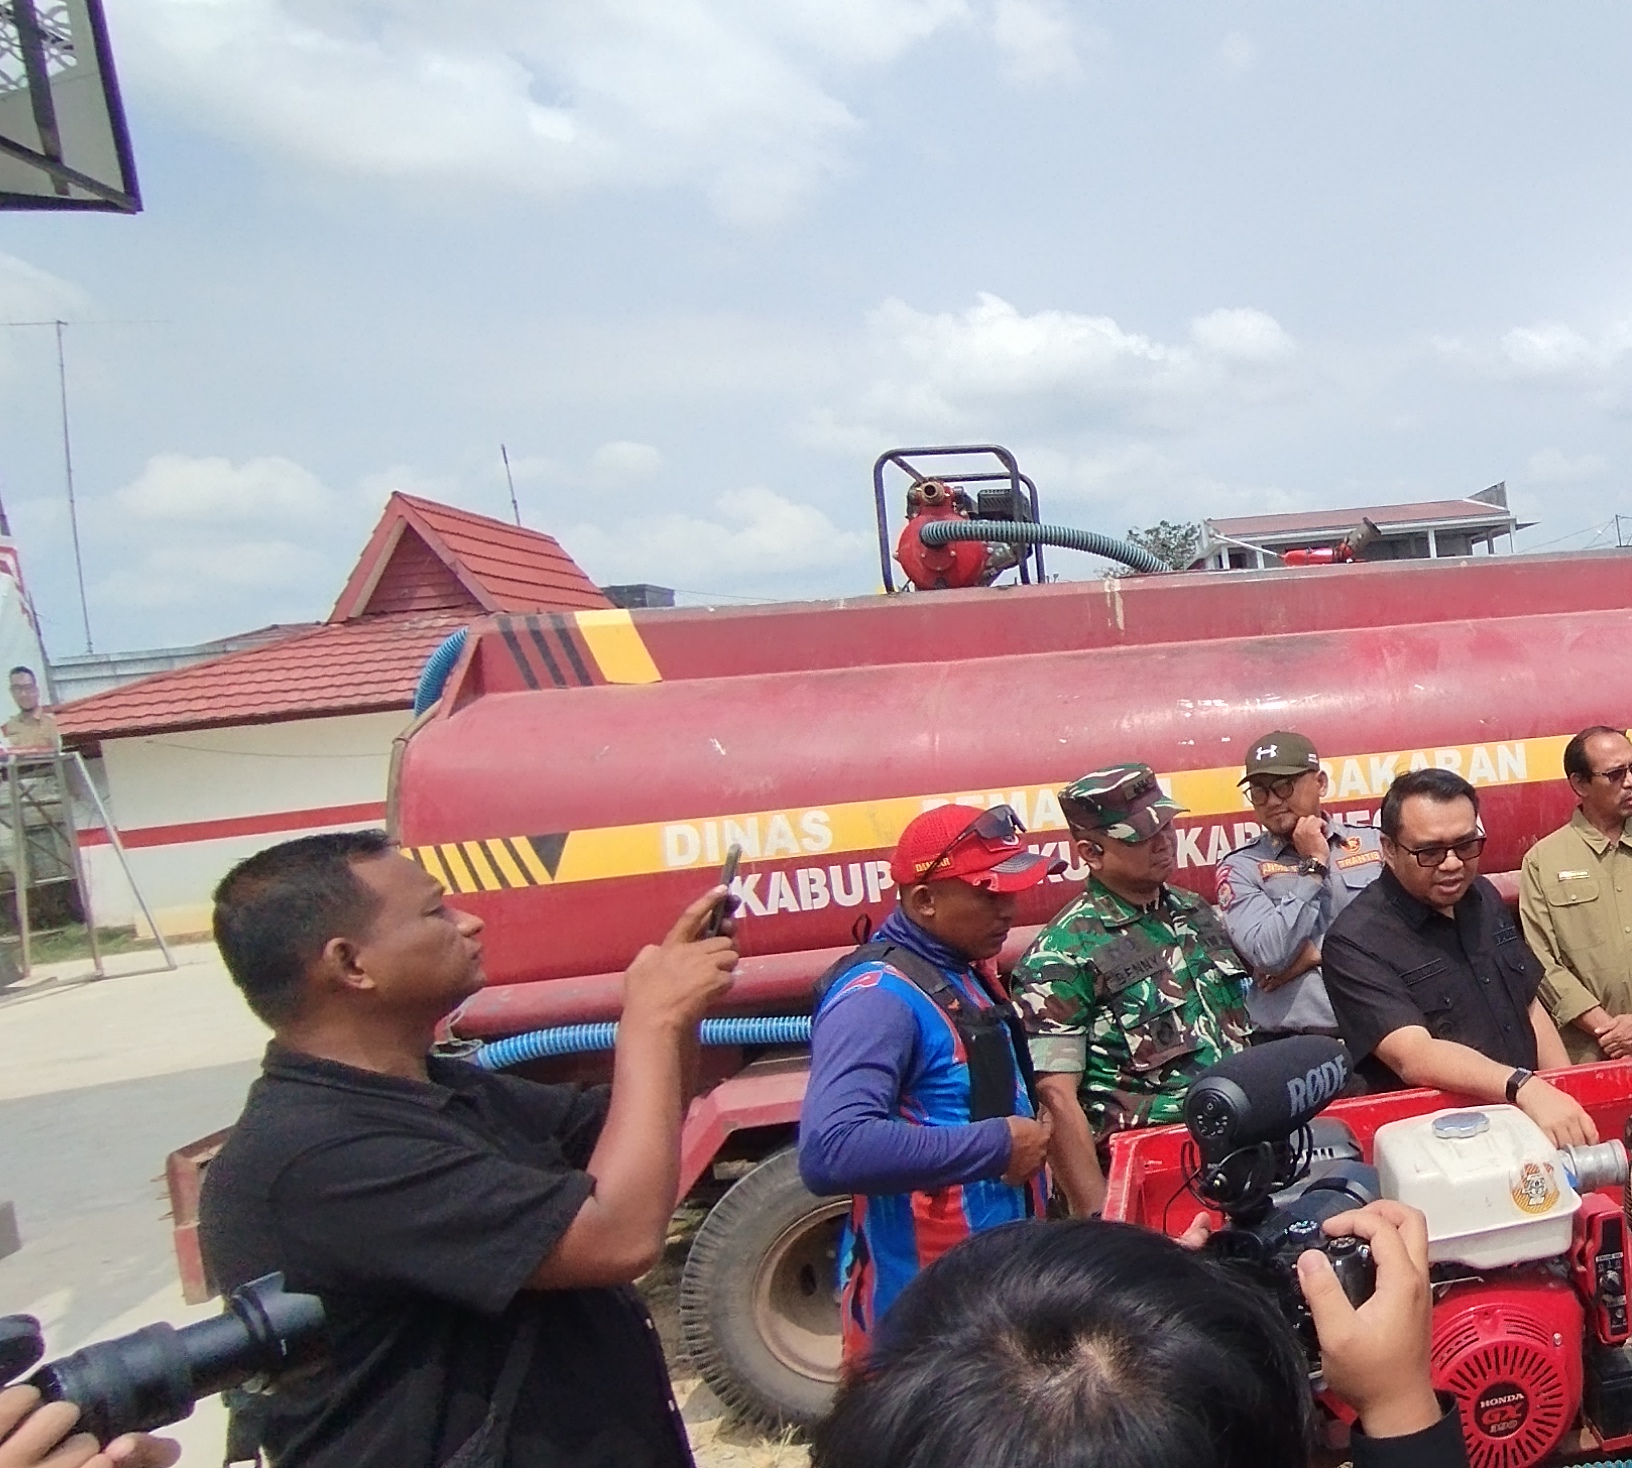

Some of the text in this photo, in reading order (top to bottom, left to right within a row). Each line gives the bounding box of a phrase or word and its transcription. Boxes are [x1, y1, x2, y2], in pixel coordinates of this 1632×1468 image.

[664, 810, 833, 867] DINAS
[915, 857, 951, 872] DAMAR
[733, 860, 899, 919] KABUP
[1480, 1393, 1525, 1409] HONDA
[1482, 1401, 1523, 1425] GX
